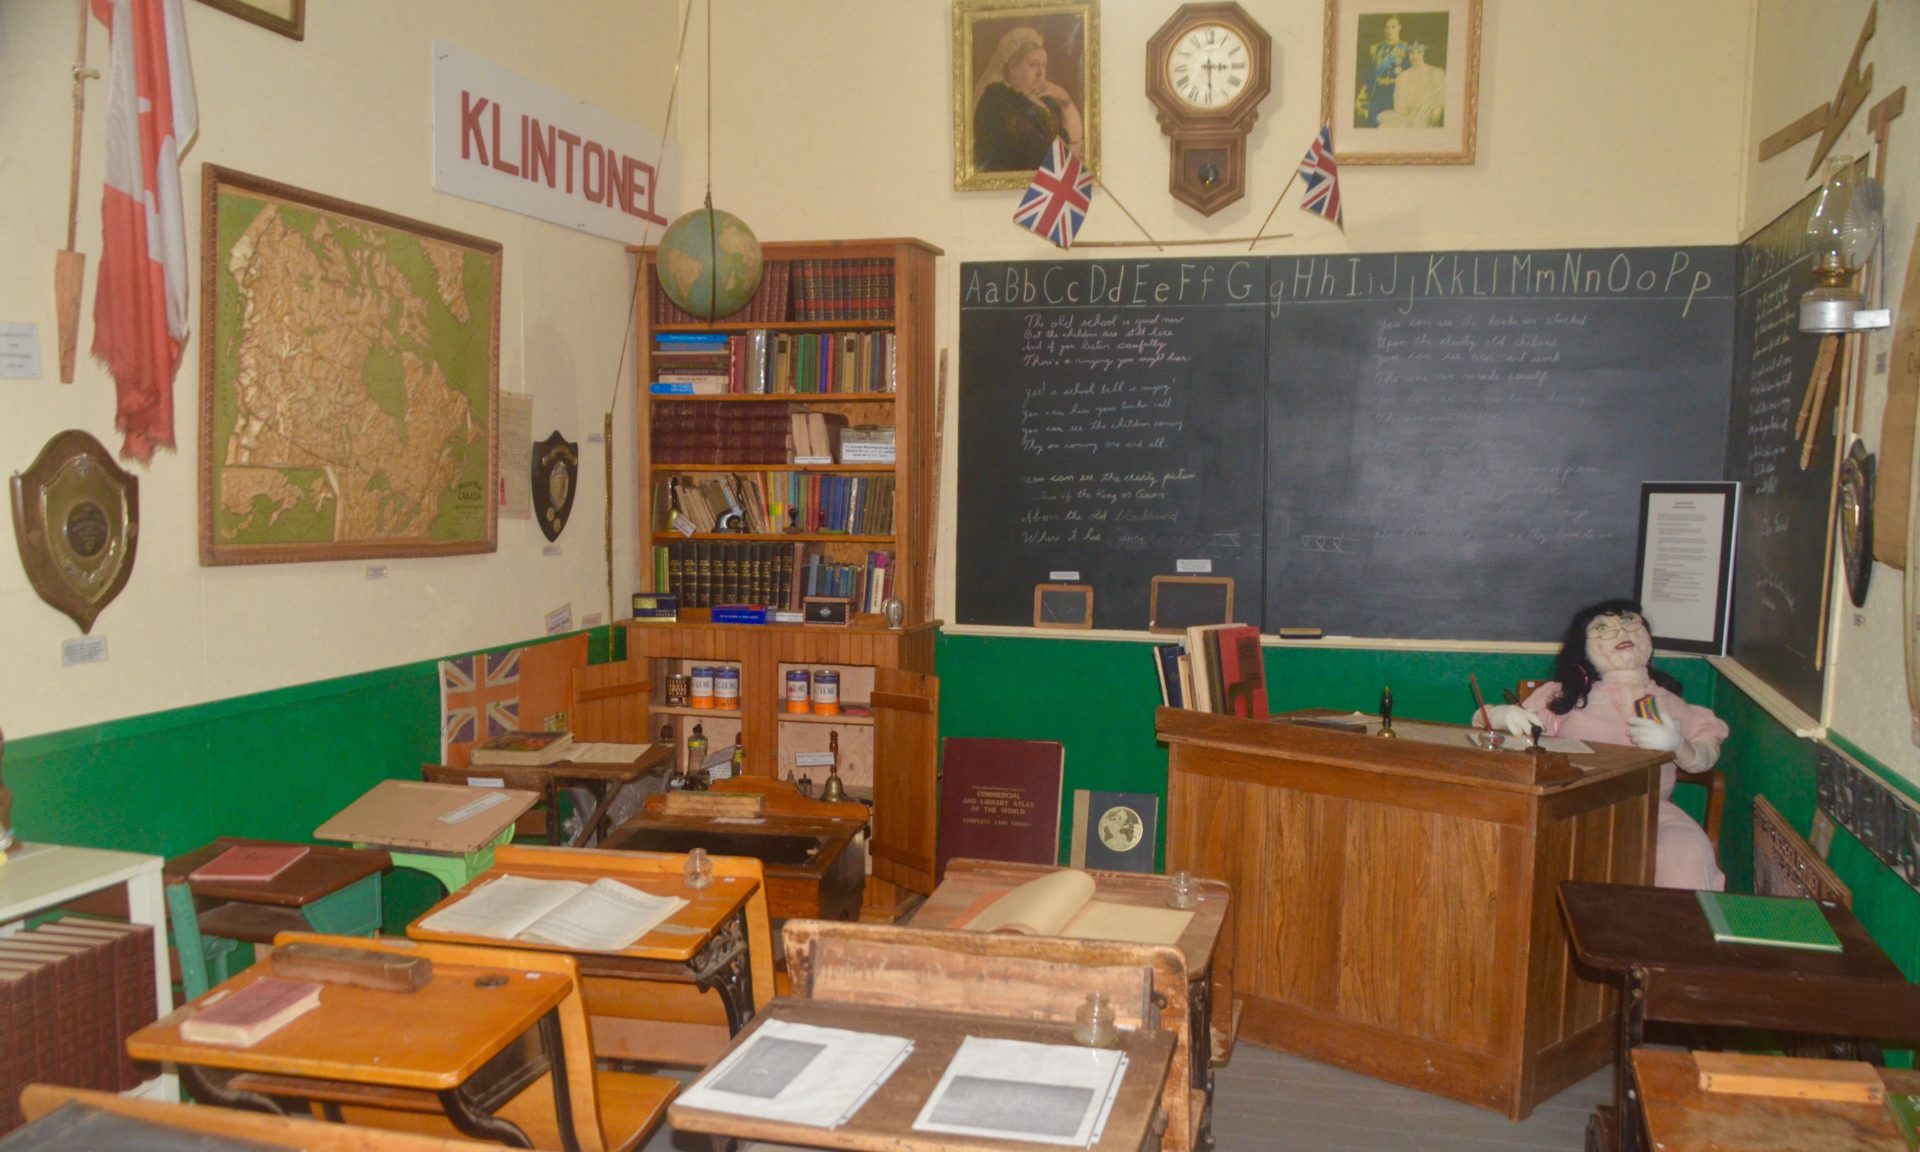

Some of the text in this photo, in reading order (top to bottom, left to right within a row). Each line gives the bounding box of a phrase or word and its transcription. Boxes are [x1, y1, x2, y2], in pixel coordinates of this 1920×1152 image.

[461, 89, 668, 227] KLINTONEL
[1050, 314, 1073, 328] old
[1079, 312, 1118, 327] school
[1045, 328, 1059, 338] the
[1062, 328, 1098, 338] children
[1047, 340, 1056, 354] if
[1058, 342, 1075, 356] you
[1062, 382, 1095, 396] school
[1101, 380, 1123, 395] bell
[1110, 417, 1151, 429] children
[1077, 487, 1092, 499] the
[1065, 508, 1082, 521] the
[976, 790, 1020, 799] COMMERCIAL
[980, 798, 1009, 807] LIBRARY
[1013, 801, 1035, 809] ATLAS
[984, 806, 997, 814] THE
[1000, 807, 1026, 816] WORLD
